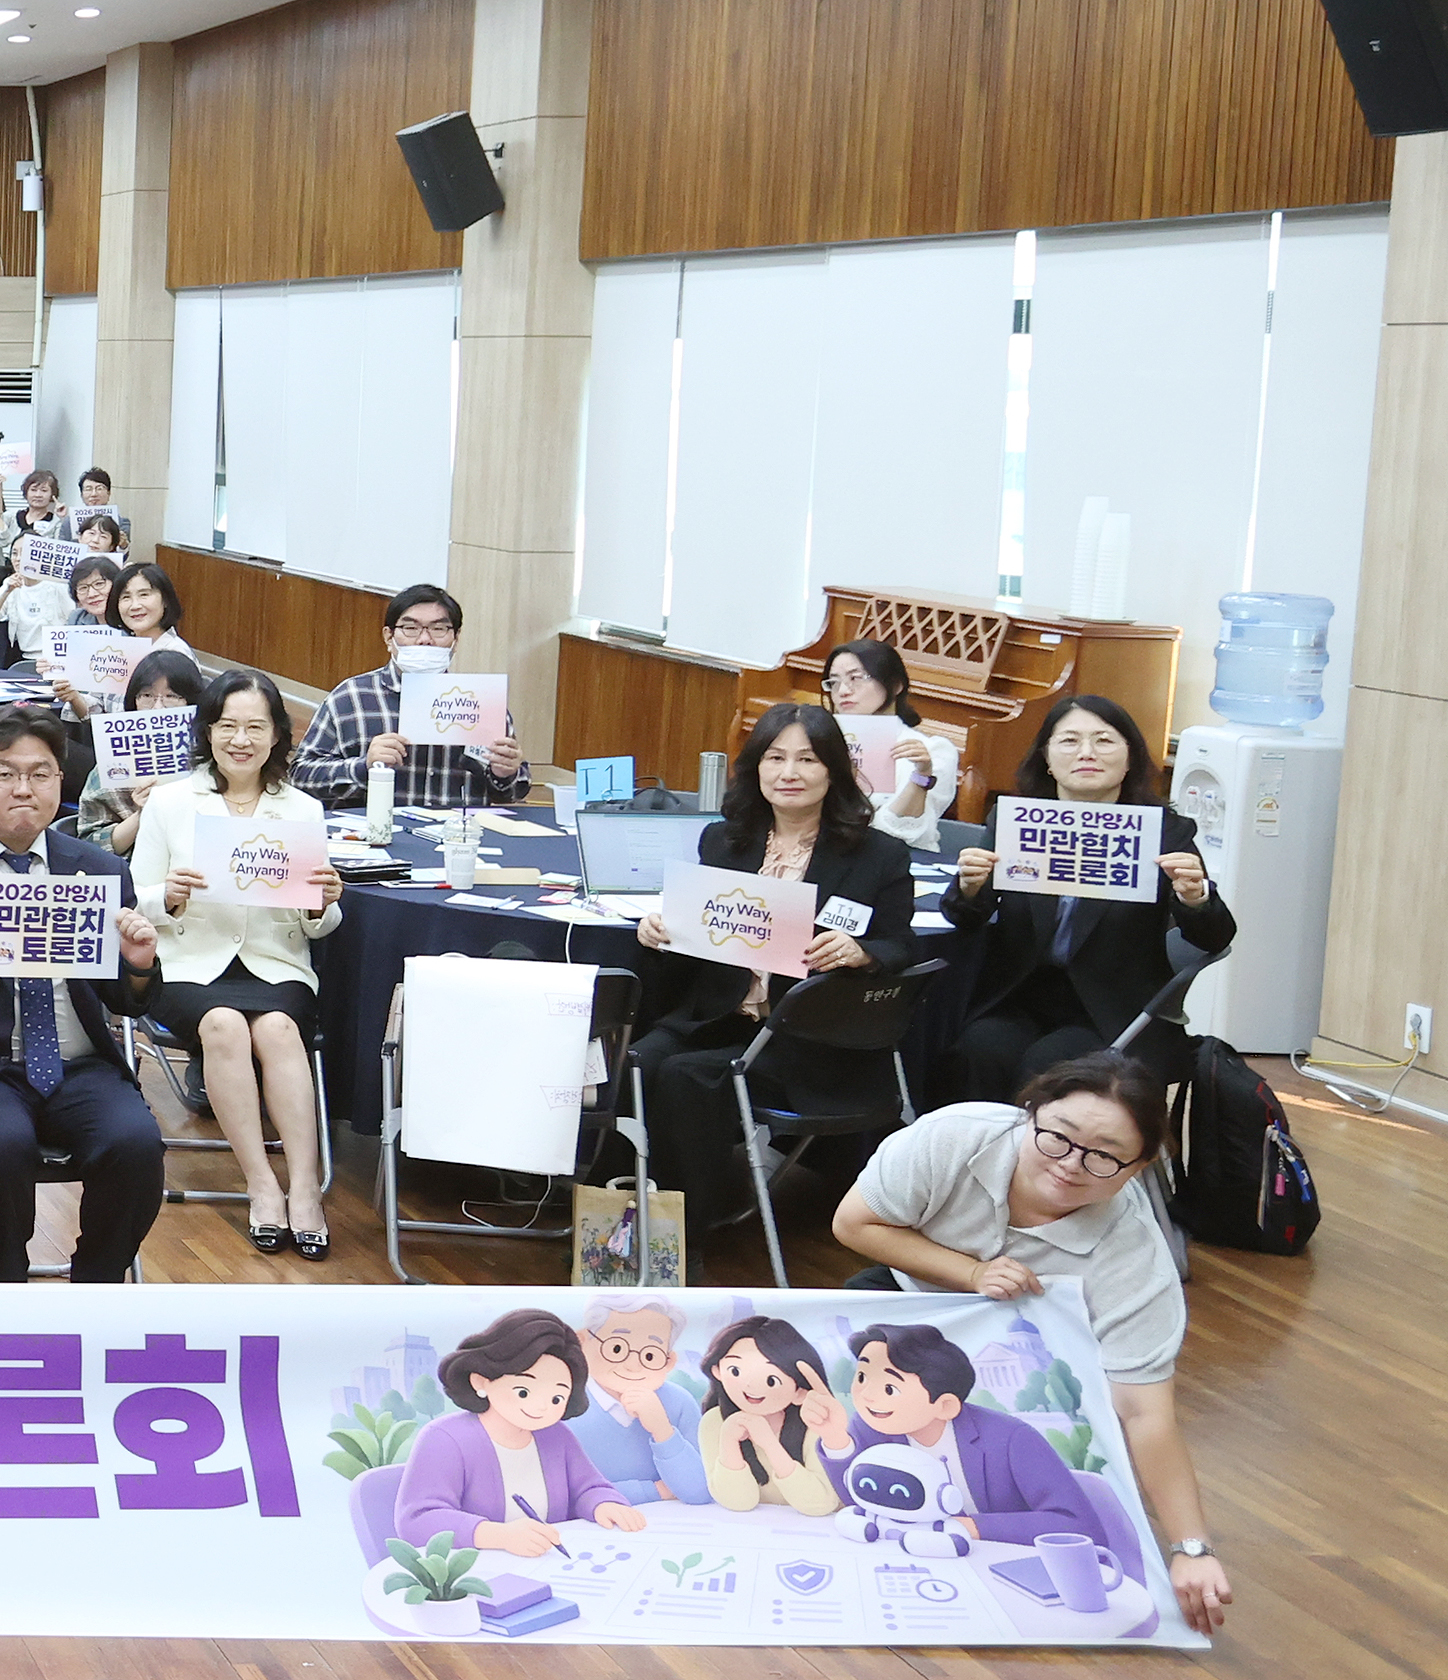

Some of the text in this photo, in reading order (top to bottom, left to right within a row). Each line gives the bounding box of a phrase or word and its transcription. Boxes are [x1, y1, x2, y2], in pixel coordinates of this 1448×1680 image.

[30, 539, 81, 555] 2026 안양시
[30, 549, 78, 567] 민관협치
[90, 654, 128, 666] Any Way,
[93, 665, 128, 677] Anyang!
[432, 698, 479, 710] Any Way,
[105, 718, 147, 733] 2026
[436, 711, 480, 723] Anyang!
[580, 764, 623, 795] T1
[1014, 807, 1142, 832] 2026 안양시
[1019, 827, 1140, 861] 민관협치
[231, 848, 289, 863] Any Way,
[236, 863, 289, 880] Anyang!
[1047, 858, 1138, 888] 토론회
[53, 884, 106, 904] 안양시
[704, 900, 772, 923] Any Way,
[838, 904, 853, 917] T1
[709, 917, 771, 940] Anyang!
[823, 911, 858, 931] 김미경
[21, 937, 103, 965] 토론회
